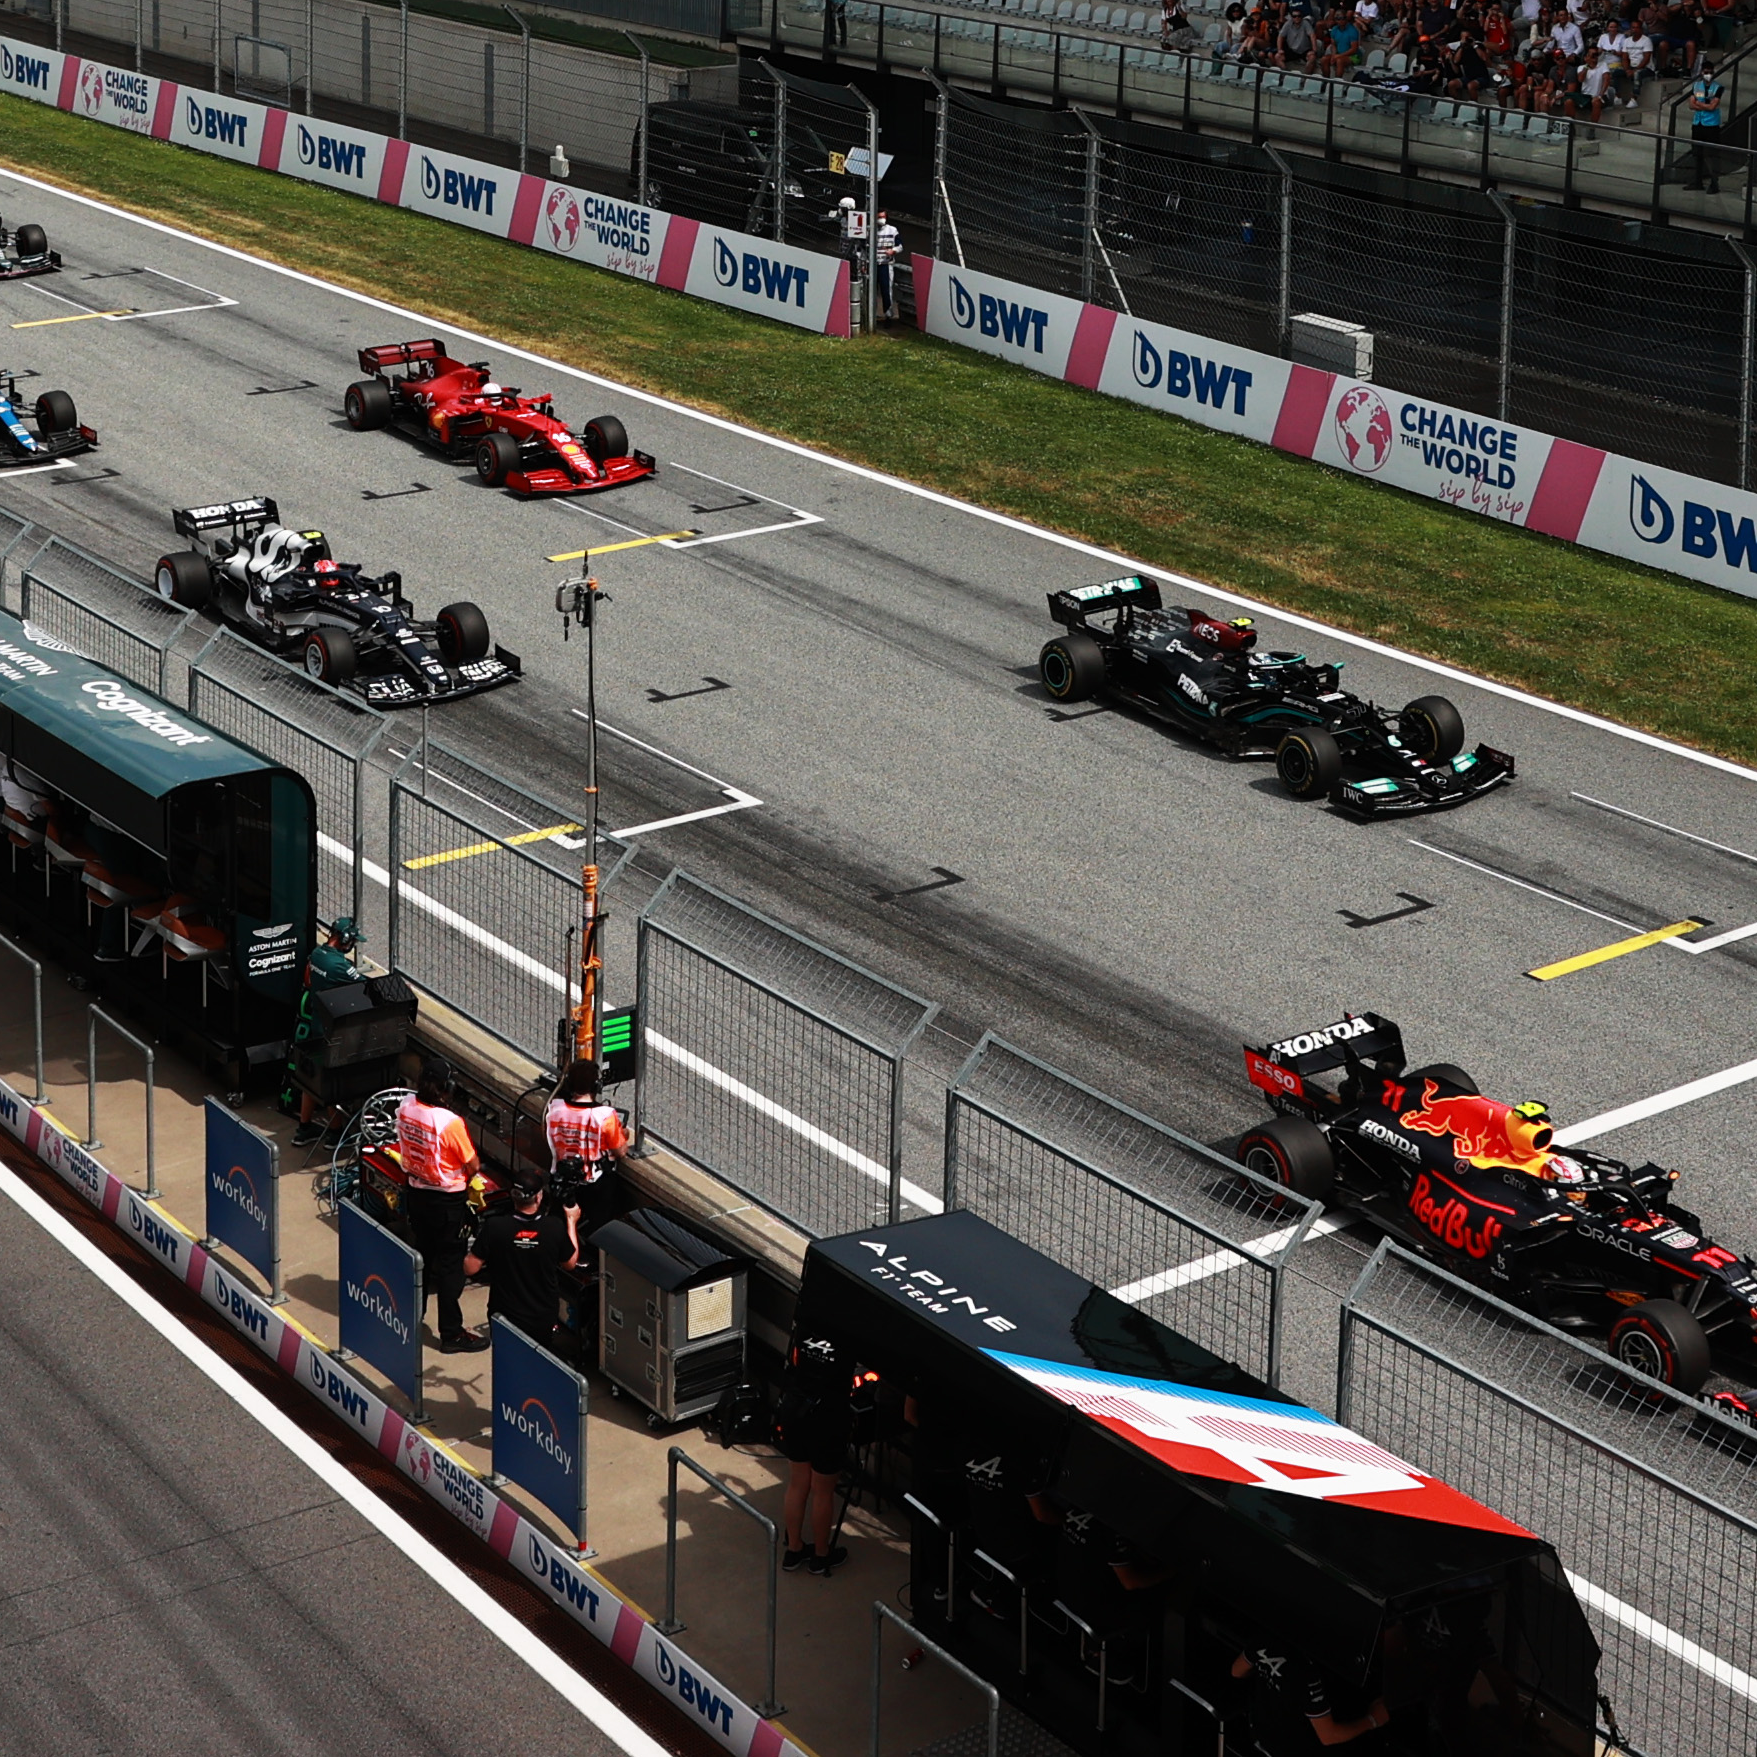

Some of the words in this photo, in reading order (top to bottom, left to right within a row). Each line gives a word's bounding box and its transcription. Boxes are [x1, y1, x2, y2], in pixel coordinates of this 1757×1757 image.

[15, 54, 49, 90] BWT
[105, 70, 147, 97] CHANGE
[113, 92, 147, 115] WORLD
[205, 107, 247, 147] BWT
[318, 135, 365, 178] BWT
[444, 168, 496, 215] BWT
[584, 196, 650, 234] CHANGE
[584, 220, 597, 232] THE
[597, 222, 650, 256] WORLD
[606, 252, 622, 270] sip
[625, 244, 636, 276] by
[639, 257, 655, 283] sip
[743, 253, 809, 308] BWT
[979, 292, 1048, 353] BWT
[1166, 350, 1252, 416] BWT
[1400, 402, 1517, 461] CHANGE
[1399, 433, 1421, 450] THE
[1421, 442, 1516, 489] WORLD
[190, 499, 262, 519] HONDA
[1439, 477, 1465, 504] sip
[1472, 472, 1492, 514] by
[1496, 488, 1524, 522] sip
[1057, 595, 1081, 611] EPSON
[81, 680, 210, 746] Cognizant
[1342, 788, 1364, 803] IWC
[248, 942, 271, 954] ASTON
[272, 937, 297, 948] MARTIN
[248, 951, 296, 969] Cognizant
[1272, 1017, 1375, 1057] HONDA
[1254, 1060, 1295, 1090] ESSO
[63, 1138, 99, 1178] CHANGE
[1359, 1118, 1422, 1161] HONDA
[69, 1158, 99, 1192] WORLD
[212, 1171, 267, 1231] workday
[144, 1212, 178, 1263] BWT
[1577, 1225, 1651, 1261] ORACLE
[859, 1240, 1018, 1334] ALPINE
[899, 1283, 949, 1315] TEAM
[231, 1289, 269, 1342] BWT
[347, 1280, 409, 1346] workday
[328, 1374, 369, 1426] BWT
[501, 1401, 573, 1476] workday
[432, 1450, 485, 1506] CHANGE
[443, 1475, 485, 1522] WORLD
[550, 1555, 600, 1622] BWT
[679, 1666, 734, 1737] BWT
